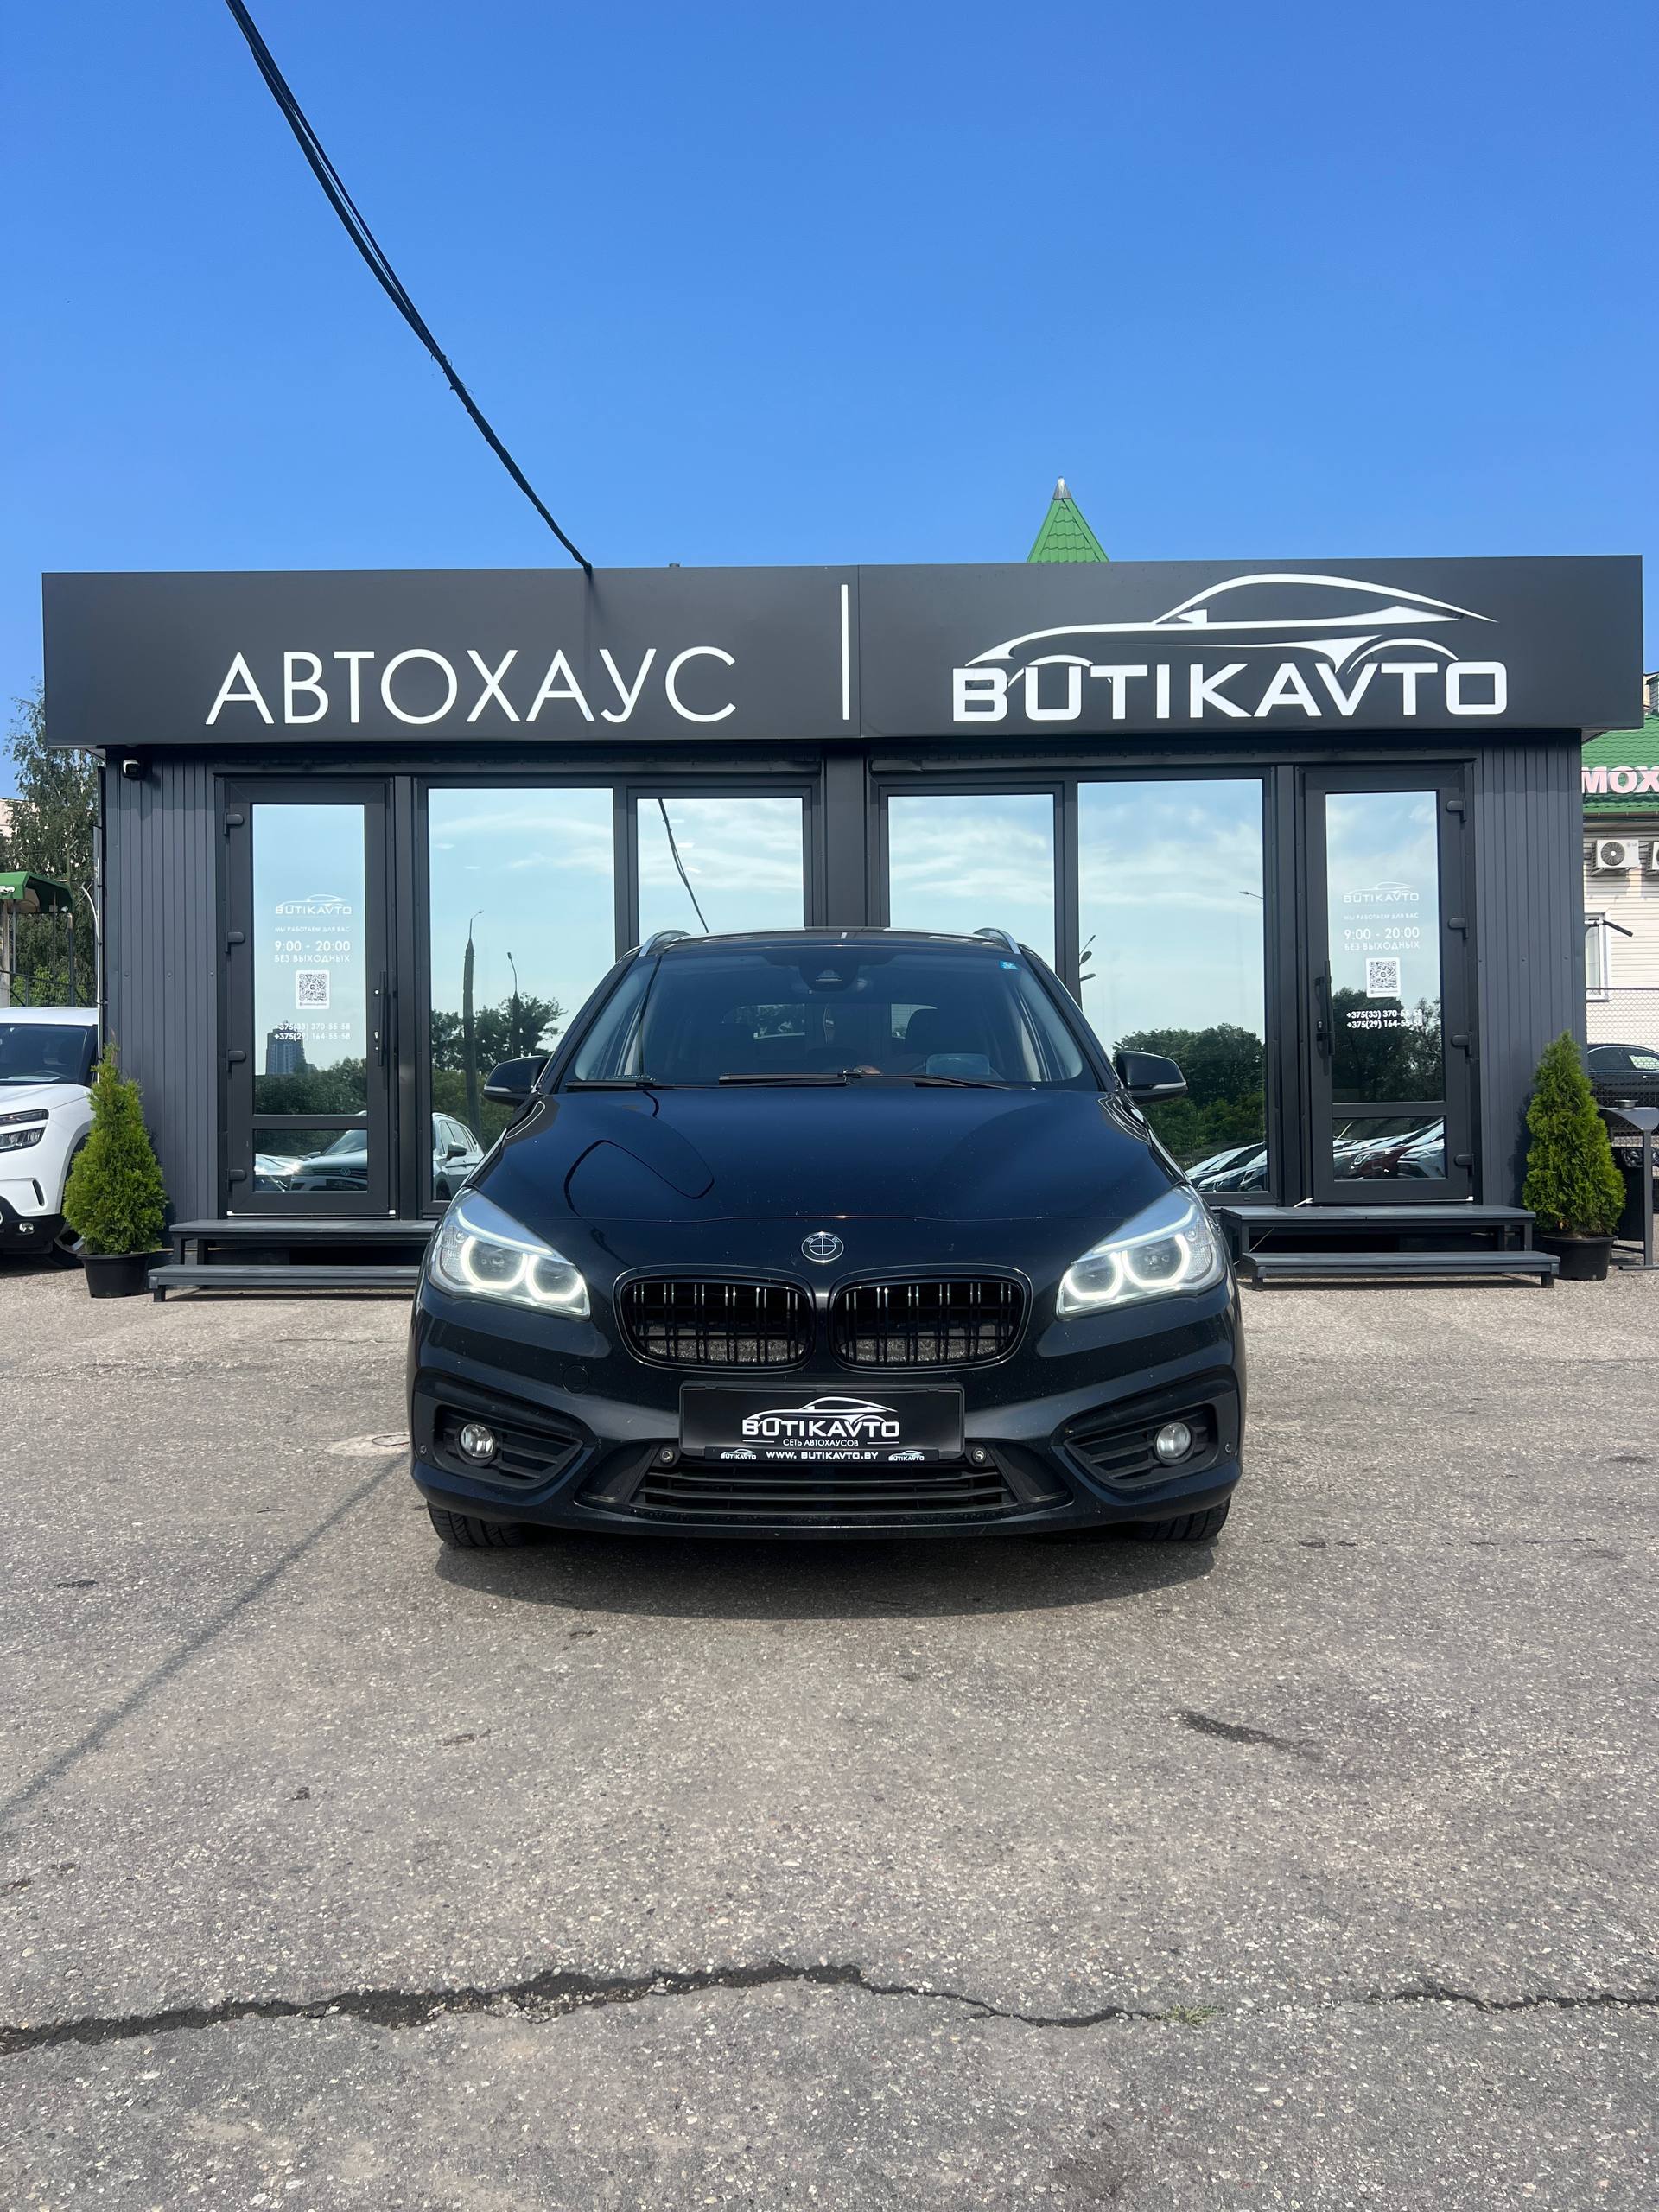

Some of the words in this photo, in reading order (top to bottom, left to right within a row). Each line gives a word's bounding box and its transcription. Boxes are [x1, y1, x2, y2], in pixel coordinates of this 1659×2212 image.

[206, 646, 736, 725] АВТОХАУС
[952, 661, 1508, 722] BUTIKAVTO
[1343, 893, 1420, 904] BUTIKAVTO
[276, 906, 352, 914] BUTIKAVTO
[1344, 927, 1371, 940] 9:00
[1384, 926, 1420, 939] 20:00
[275, 940, 302, 951] 9:00
[315, 940, 351, 952] 20:00
[1344, 943, 1360, 951] БЕЗ
[1362, 941, 1420, 951] ВЫХОДНЫХ
[274, 954, 290, 963] БЕЗ
[293, 954, 350, 963] ВЫХОДНЫХ
[1346, 1010, 1382, 1020] +375(33)
[1346, 1020, 1382, 1030] +375(29)
[741, 1419, 900, 1438] BUTIKAVTO
[783, 1439, 803, 1447] СЕТЬ
[804, 1439, 859, 1448] АВТОХАУСОВ
[800, 1452, 879, 1460] BUTIKAVTO.BY
